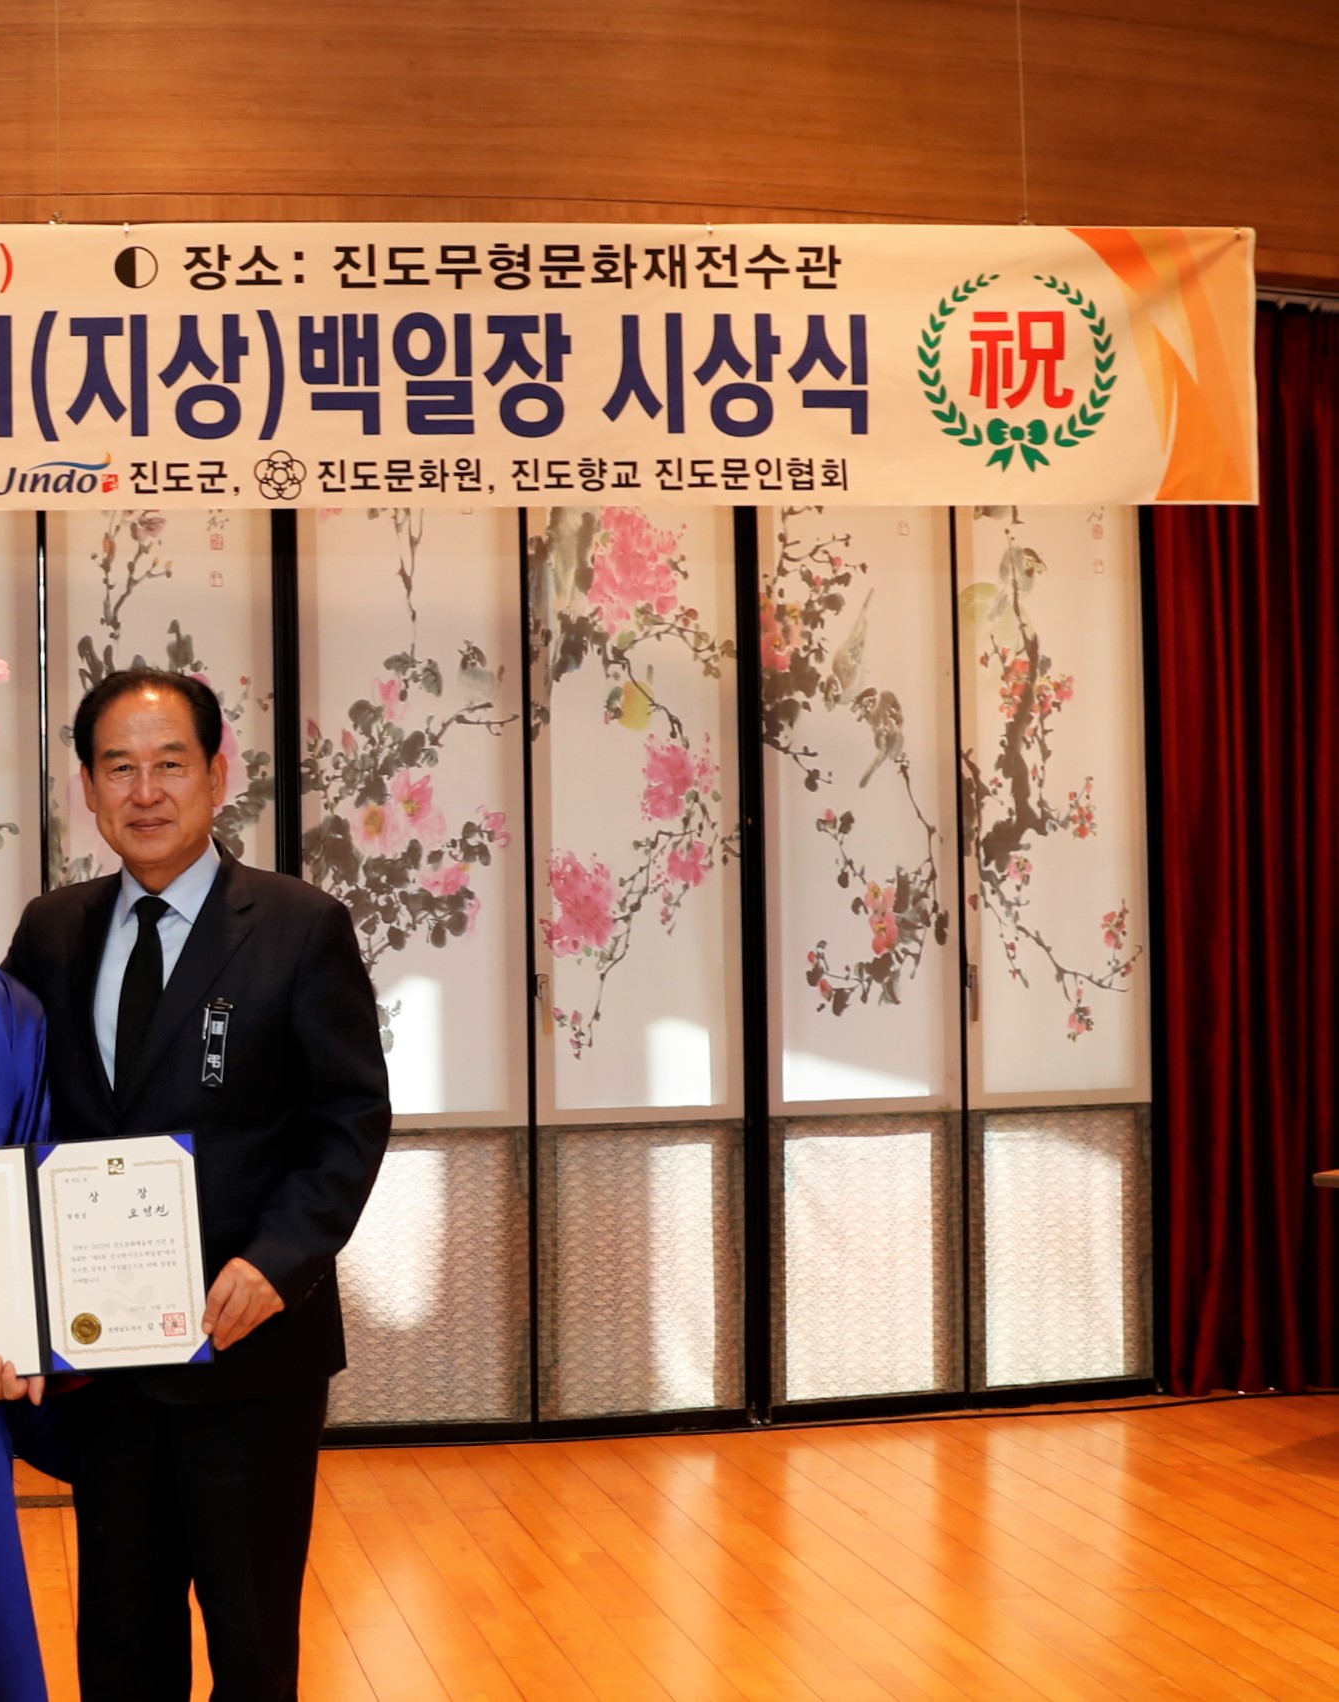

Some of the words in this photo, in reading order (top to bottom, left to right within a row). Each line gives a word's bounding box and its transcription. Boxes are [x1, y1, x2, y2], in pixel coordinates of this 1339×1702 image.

[183, 244, 305, 291] 장소:
[333, 243, 841, 291] 진도무형문화재전수관
[602, 312, 869, 438] 시상식
[969, 311, 1074, 410] 祝
[129, 461, 240, 496] 진도군,
[317, 458, 494, 495] 진도문화원,
[511, 458, 641, 492] 진도향교
[655, 457, 849, 491] 진도문인협회
